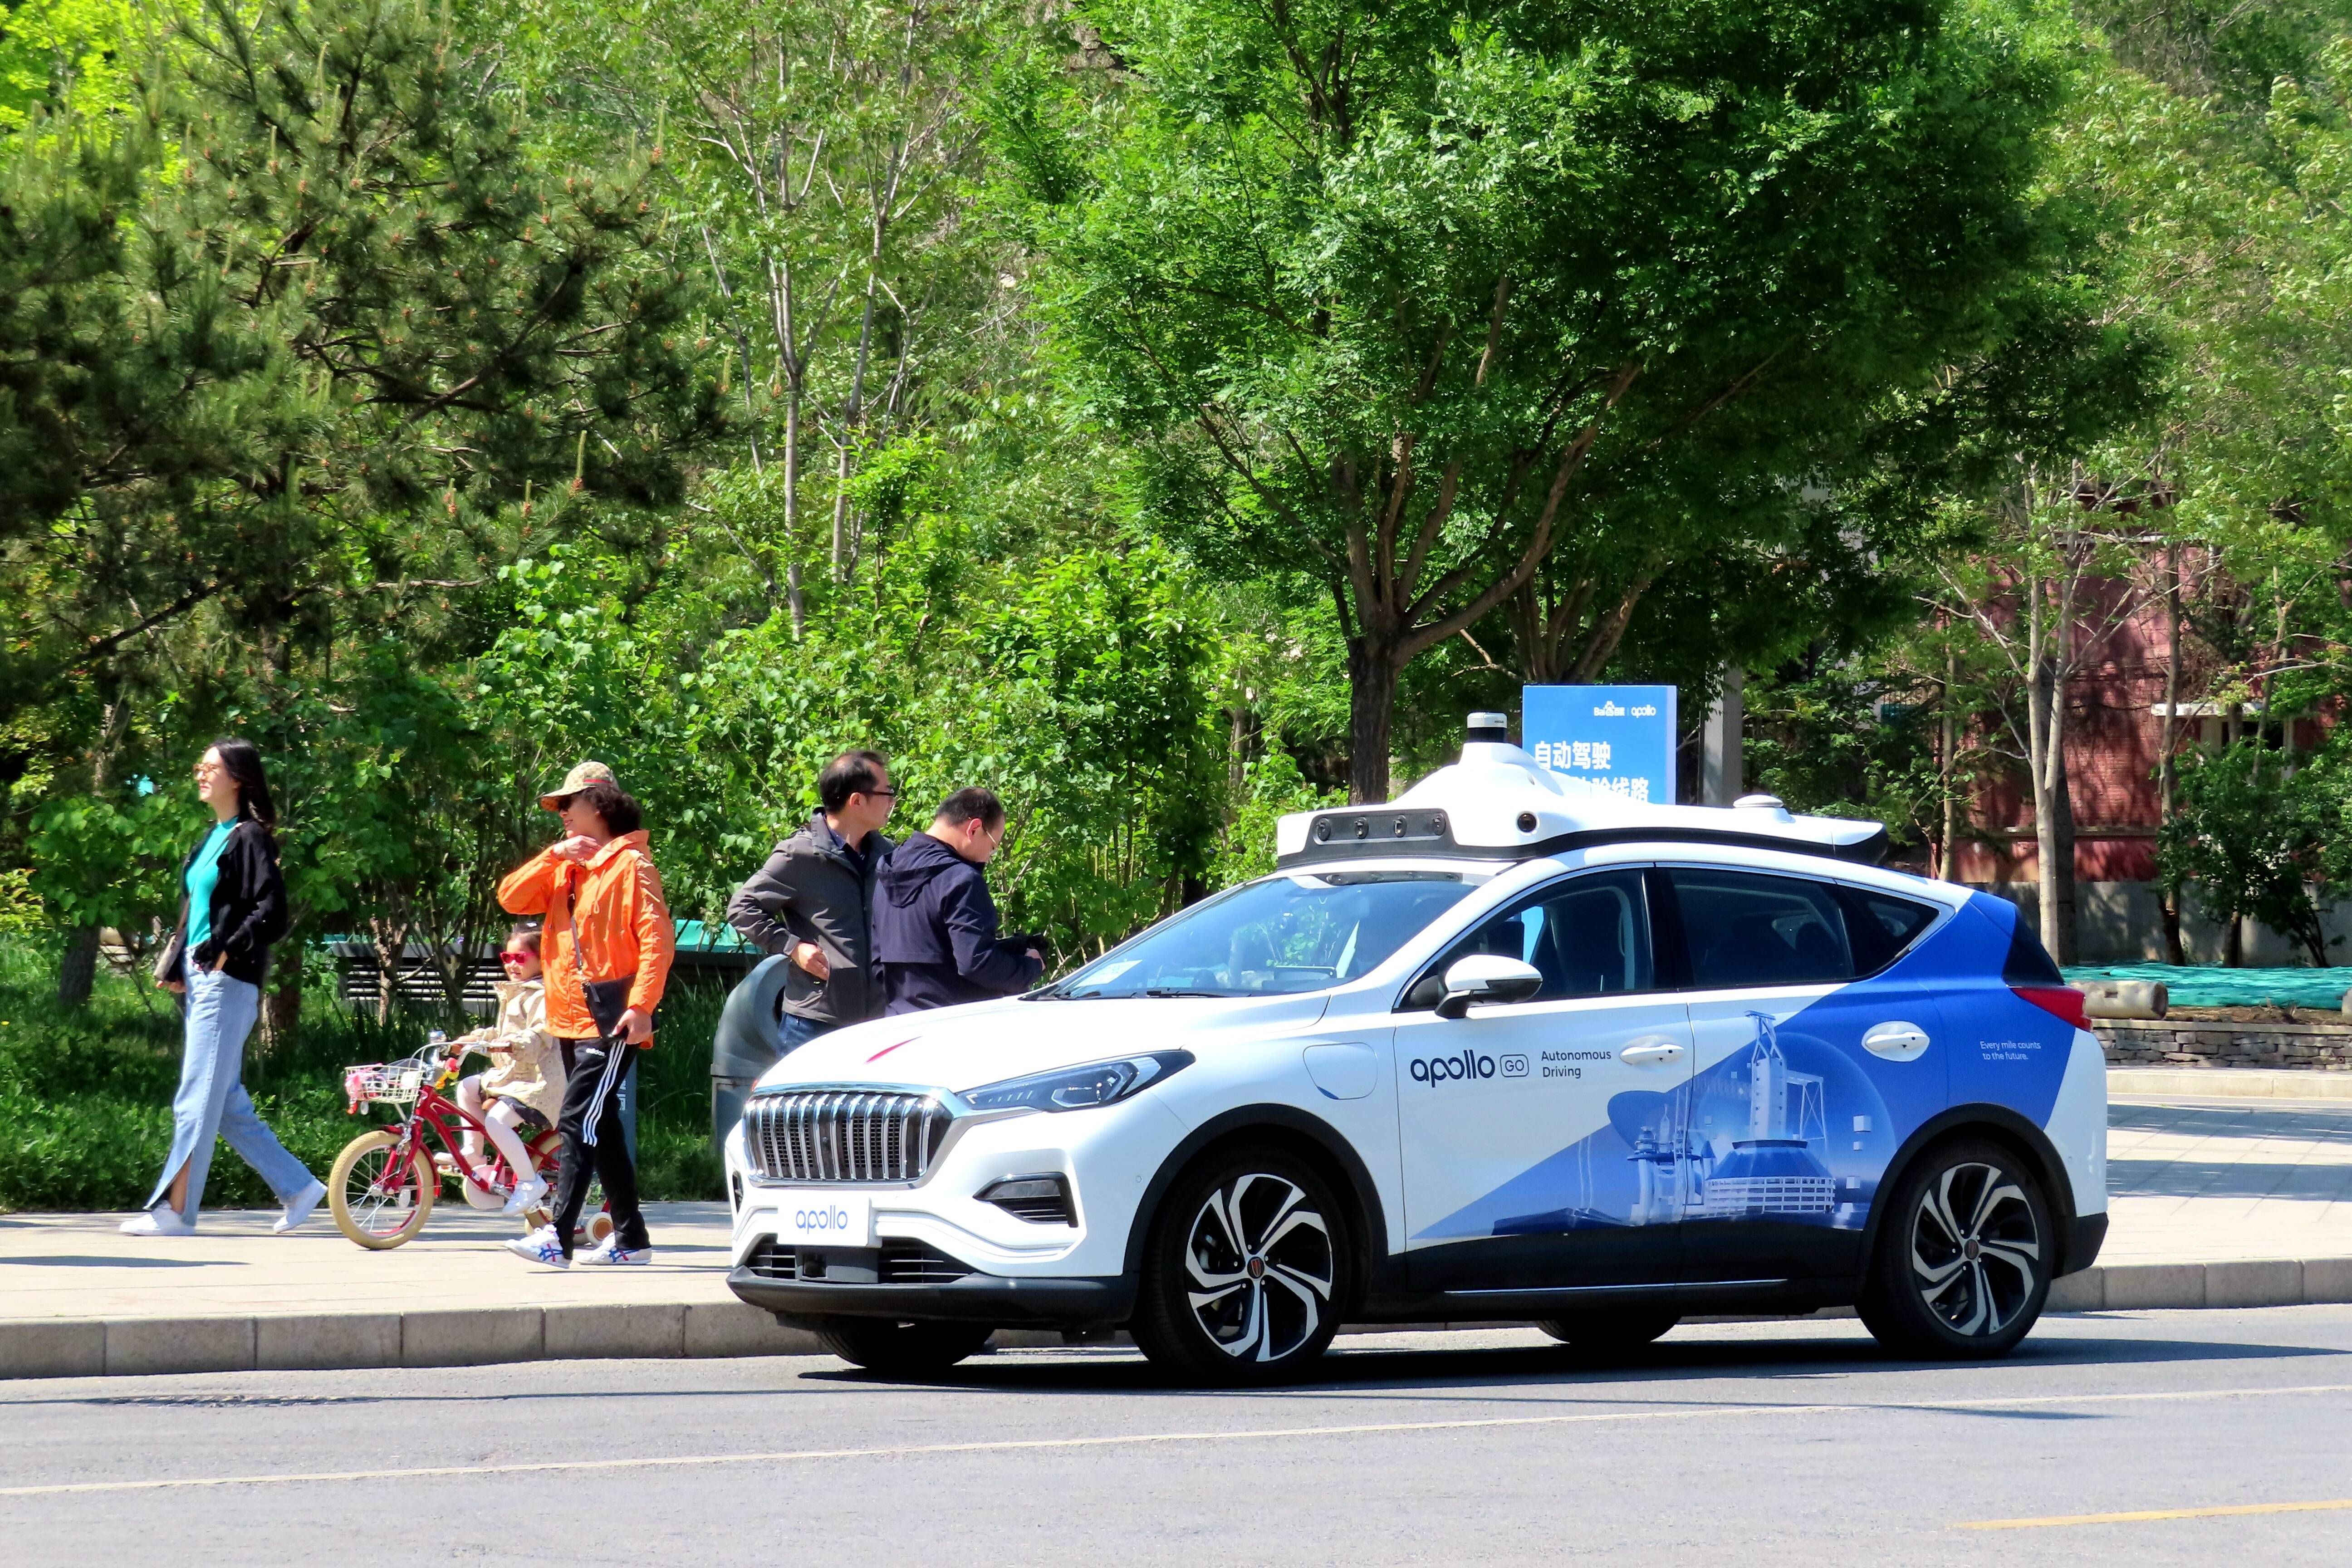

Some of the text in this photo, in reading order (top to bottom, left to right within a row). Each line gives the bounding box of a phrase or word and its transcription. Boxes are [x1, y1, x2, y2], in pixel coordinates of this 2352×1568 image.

[1631, 705, 1656, 718] apollo
[1534, 740, 1611, 770] 自动驾驶
[1980, 1041, 1999, 1050] Every
[1541, 1050, 1612, 1061] Autonomous
[1410, 1049, 1524, 1088] apollo GO
[1543, 1066, 1581, 1079] Driving
[796, 1205, 848, 1234] apollo
